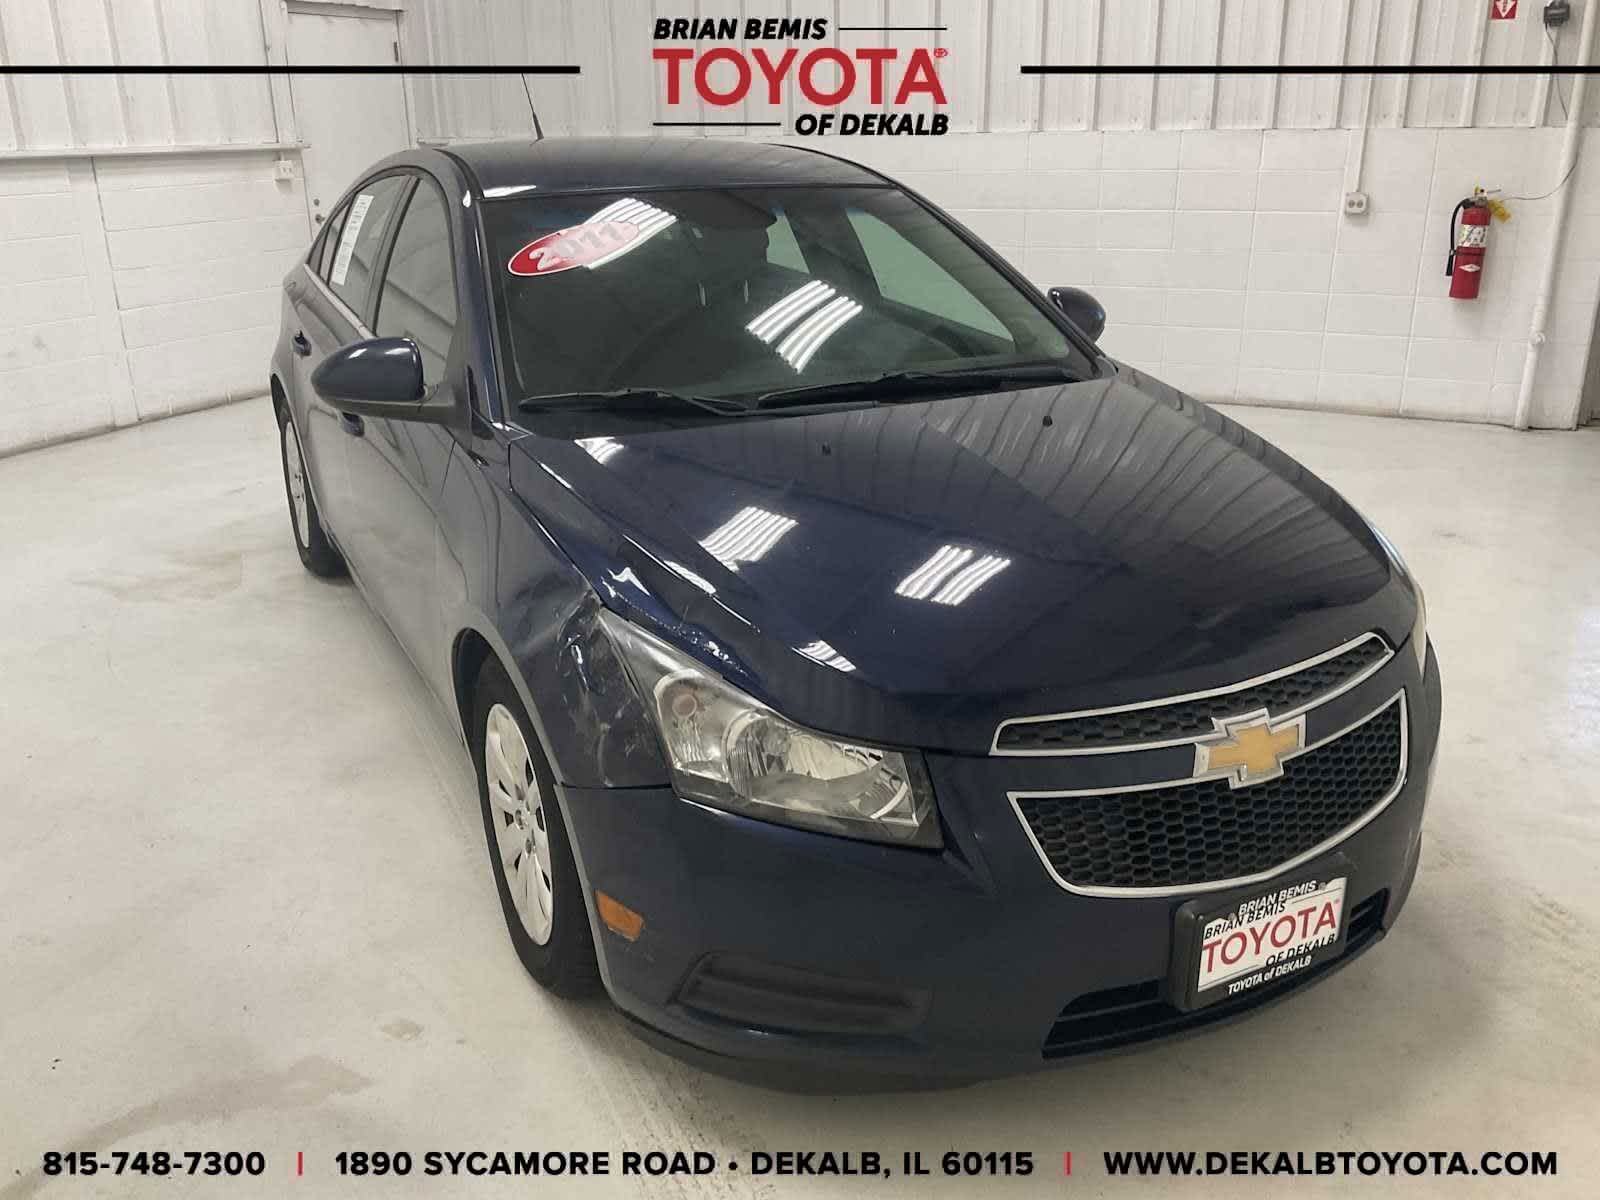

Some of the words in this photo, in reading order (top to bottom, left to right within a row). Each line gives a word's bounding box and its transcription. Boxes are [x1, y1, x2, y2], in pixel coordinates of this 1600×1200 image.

[1238, 893, 1277, 916] BRIAN
[1278, 880, 1317, 902] BEMIS
[1202, 901, 1336, 973] TOYOTA
[1204, 916, 1244, 940] BRIAN
[1246, 902, 1287, 924] BEMIS
[1284, 933, 1336, 962] DEKALB
[1228, 973, 1263, 995] TOYOTA
[1264, 967, 1274, 981] of
[1275, 956, 1312, 977] DEKALB
